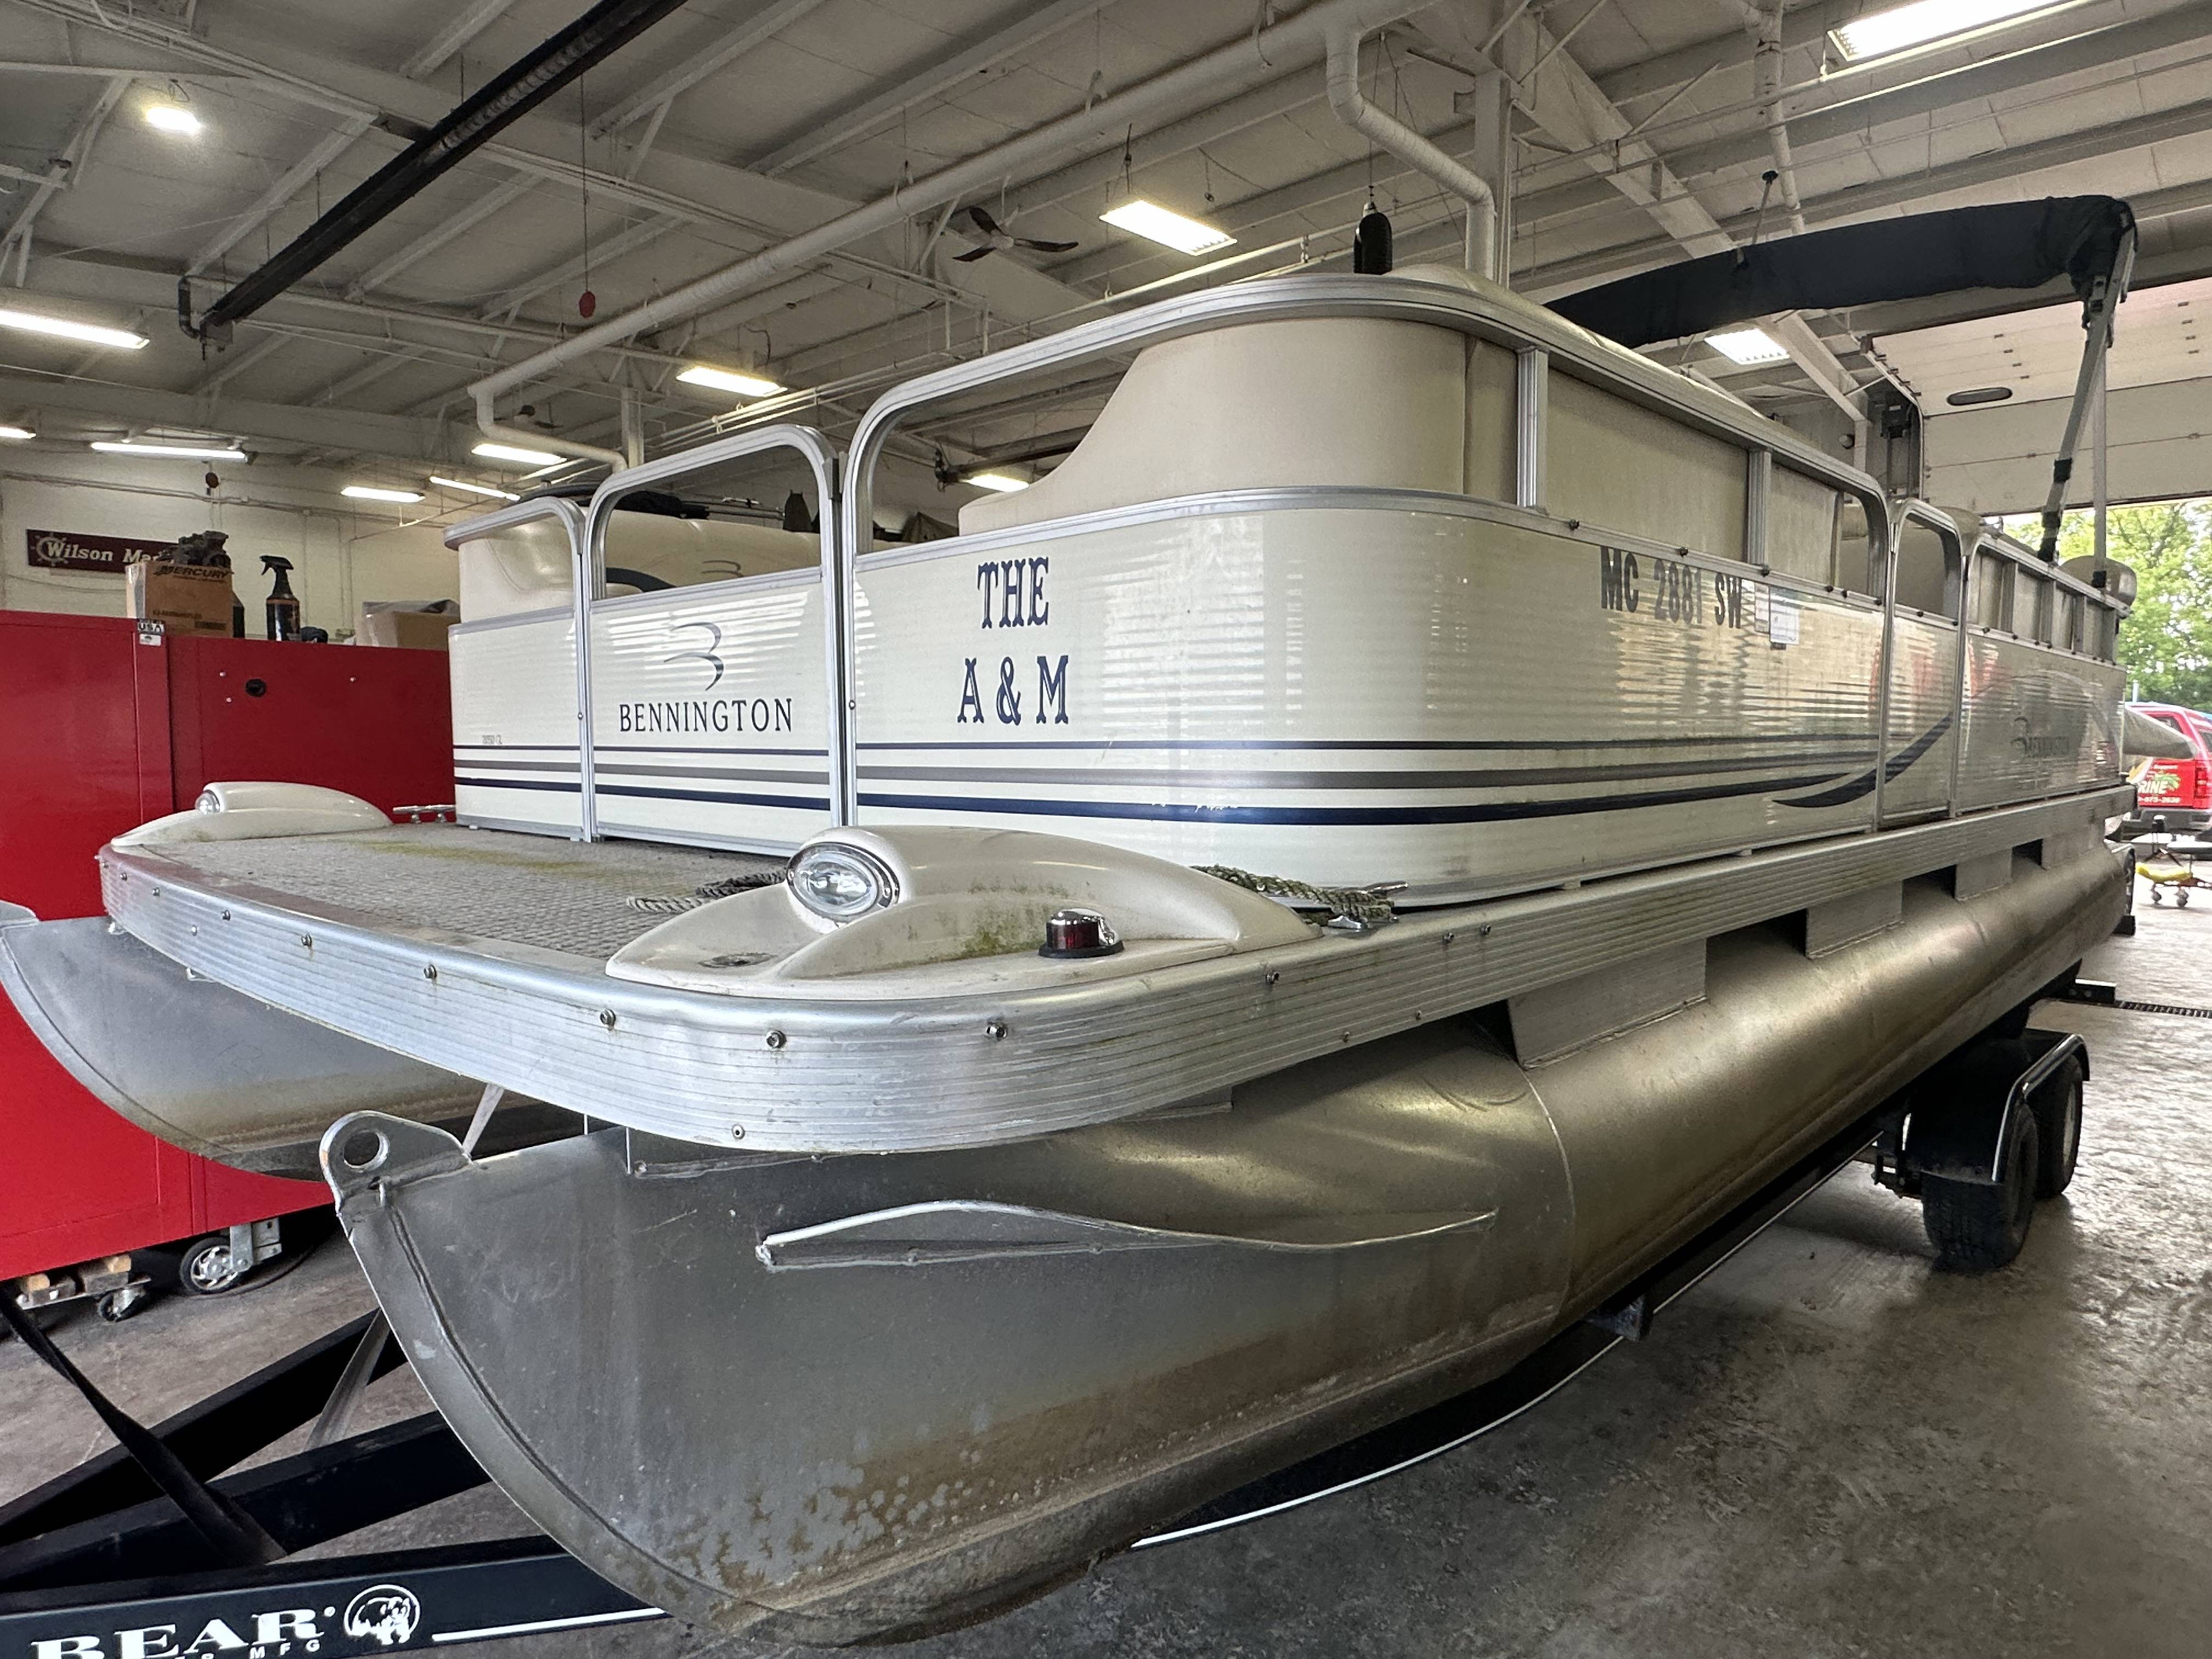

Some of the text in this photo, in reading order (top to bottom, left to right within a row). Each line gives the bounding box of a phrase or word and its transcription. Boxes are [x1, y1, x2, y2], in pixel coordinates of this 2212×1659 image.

[47, 541, 166, 563] Wilson Mar
[153, 565, 235, 579] MERCURY
[1600, 546, 1639, 613] MC
[1714, 572, 1742, 629] SW
[977, 556, 1049, 629] THE
[957, 655, 1069, 726] A & M
[619, 698, 792, 733] BENNINGTON
[2138, 780, 2168, 794] RINE
